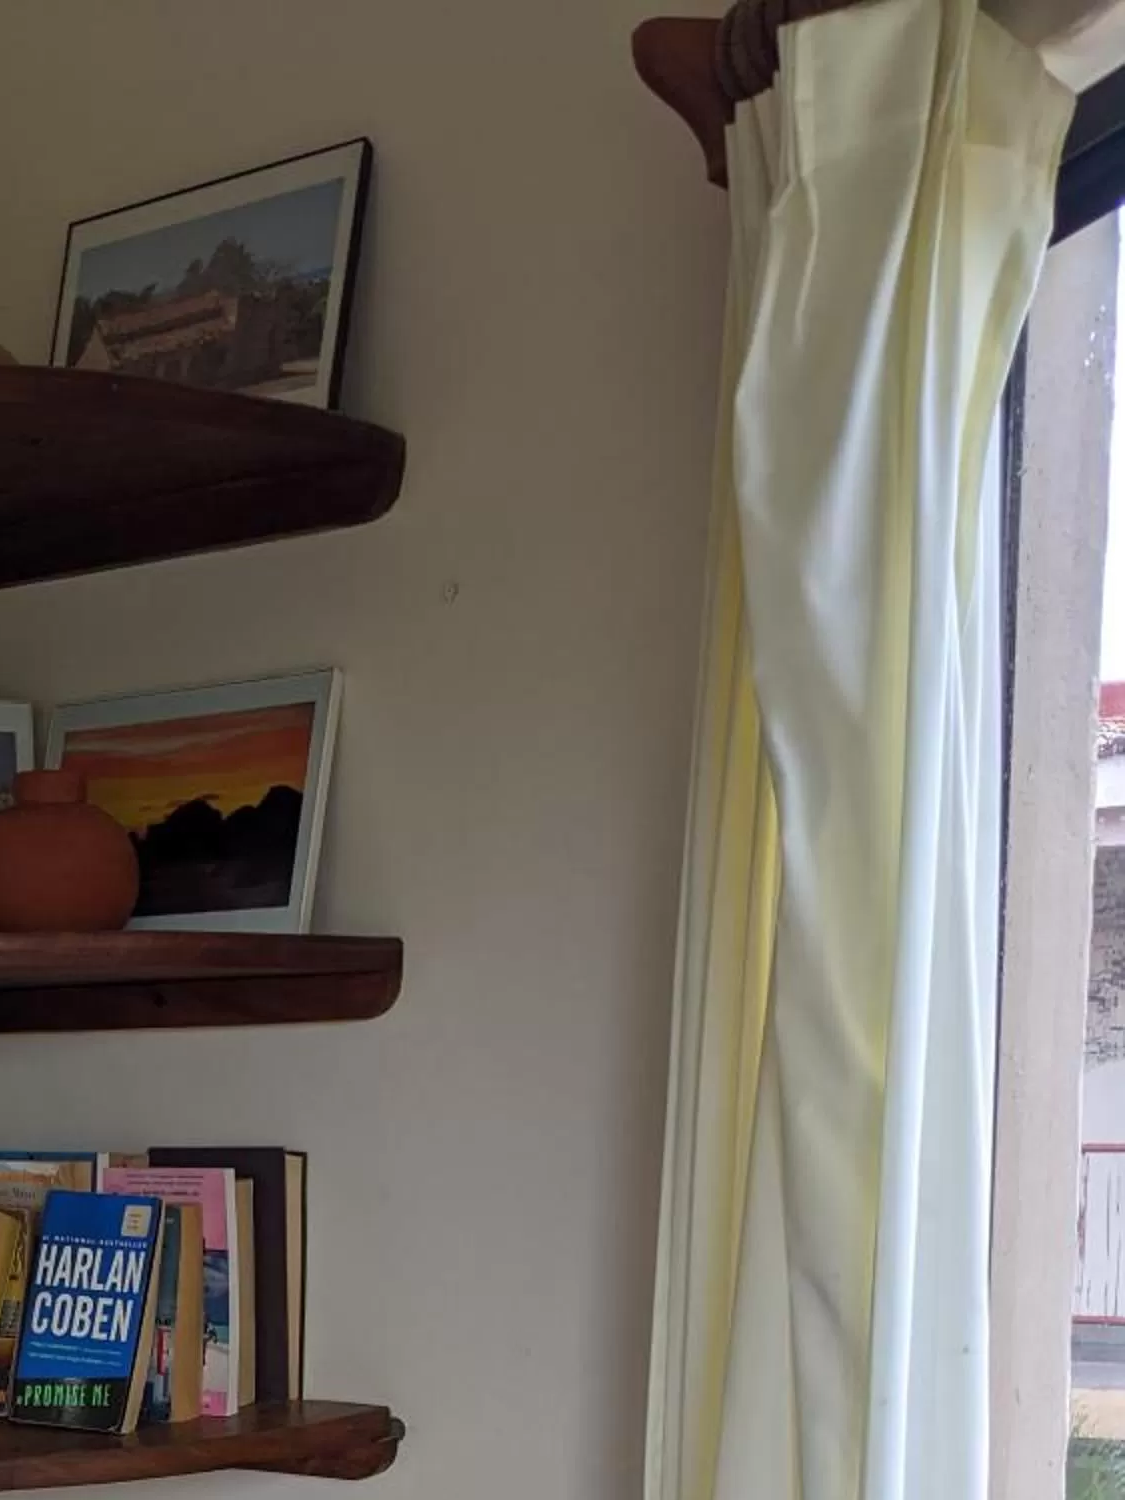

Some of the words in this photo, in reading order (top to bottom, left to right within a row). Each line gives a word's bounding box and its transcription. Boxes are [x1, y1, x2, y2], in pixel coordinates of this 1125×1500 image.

[36, 1243, 145, 1294] HARLAN
[31, 1291, 133, 1343] COBEN
[24, 1384, 87, 1406] PROMISE
[92, 1385, 111, 1407] ME
